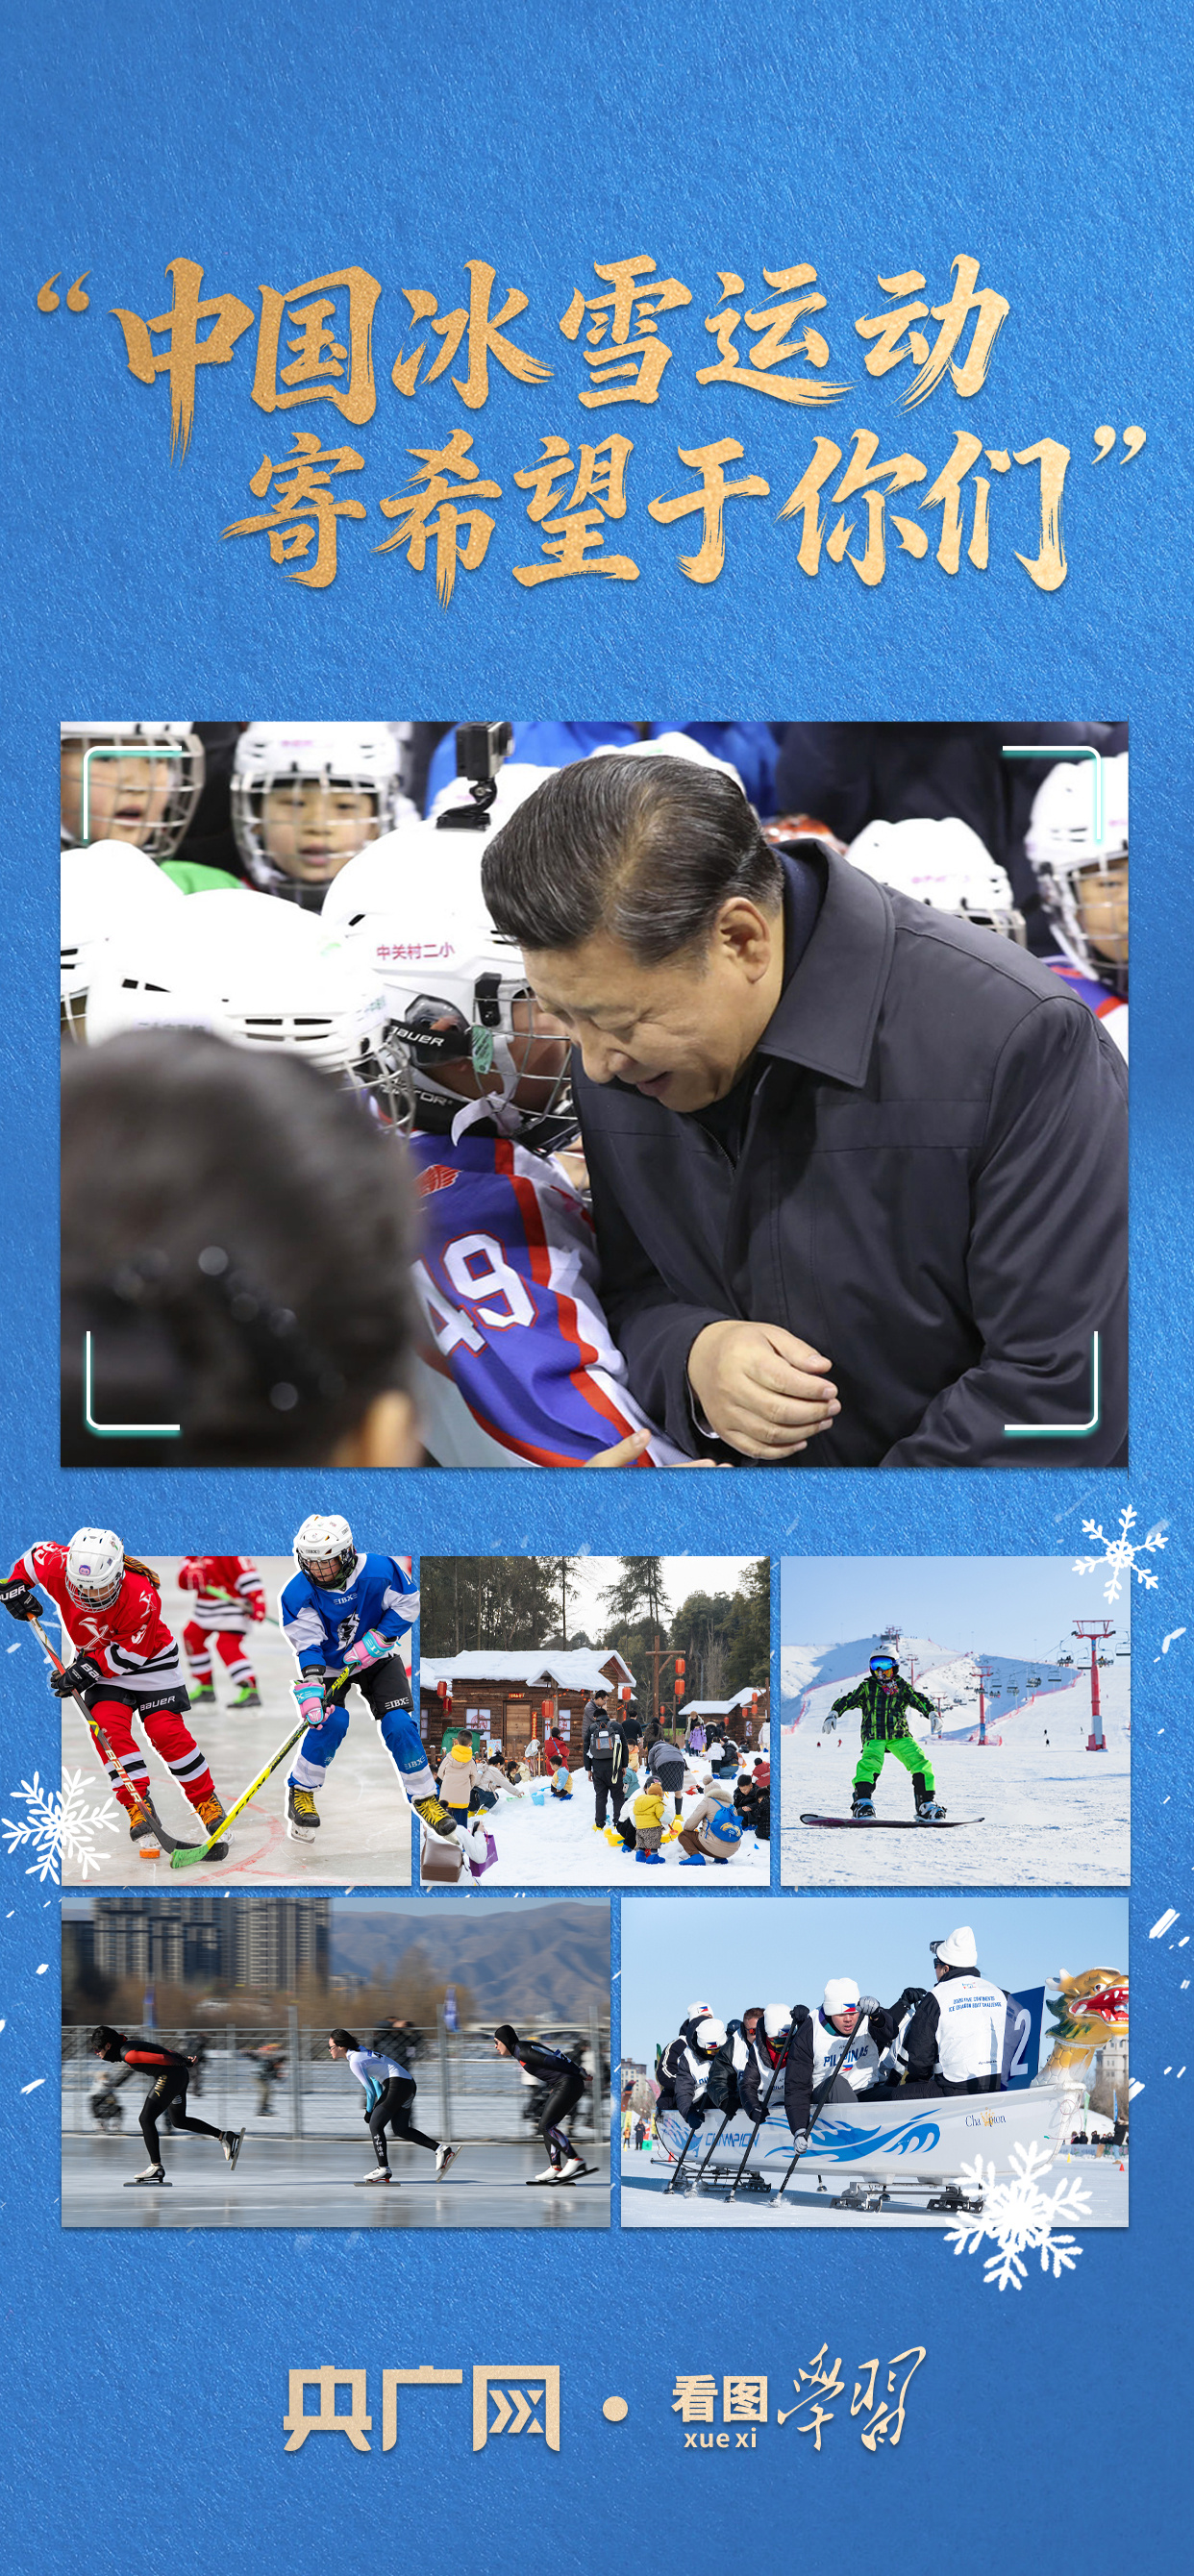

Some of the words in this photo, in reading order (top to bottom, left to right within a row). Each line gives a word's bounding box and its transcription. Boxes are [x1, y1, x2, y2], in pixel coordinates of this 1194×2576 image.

[377, 942, 455, 960] 中关村二小
[410, 1231, 537, 1357] 49
[336, 1595, 355, 1605] IBX
[139, 1696, 176, 1712] BAUER
[388, 1697, 406, 1709] IBX
[408, 1758, 424, 1770] IBX
[1010, 2008, 1032, 2077] 2
[824, 2045, 869, 2068] PILINAS
